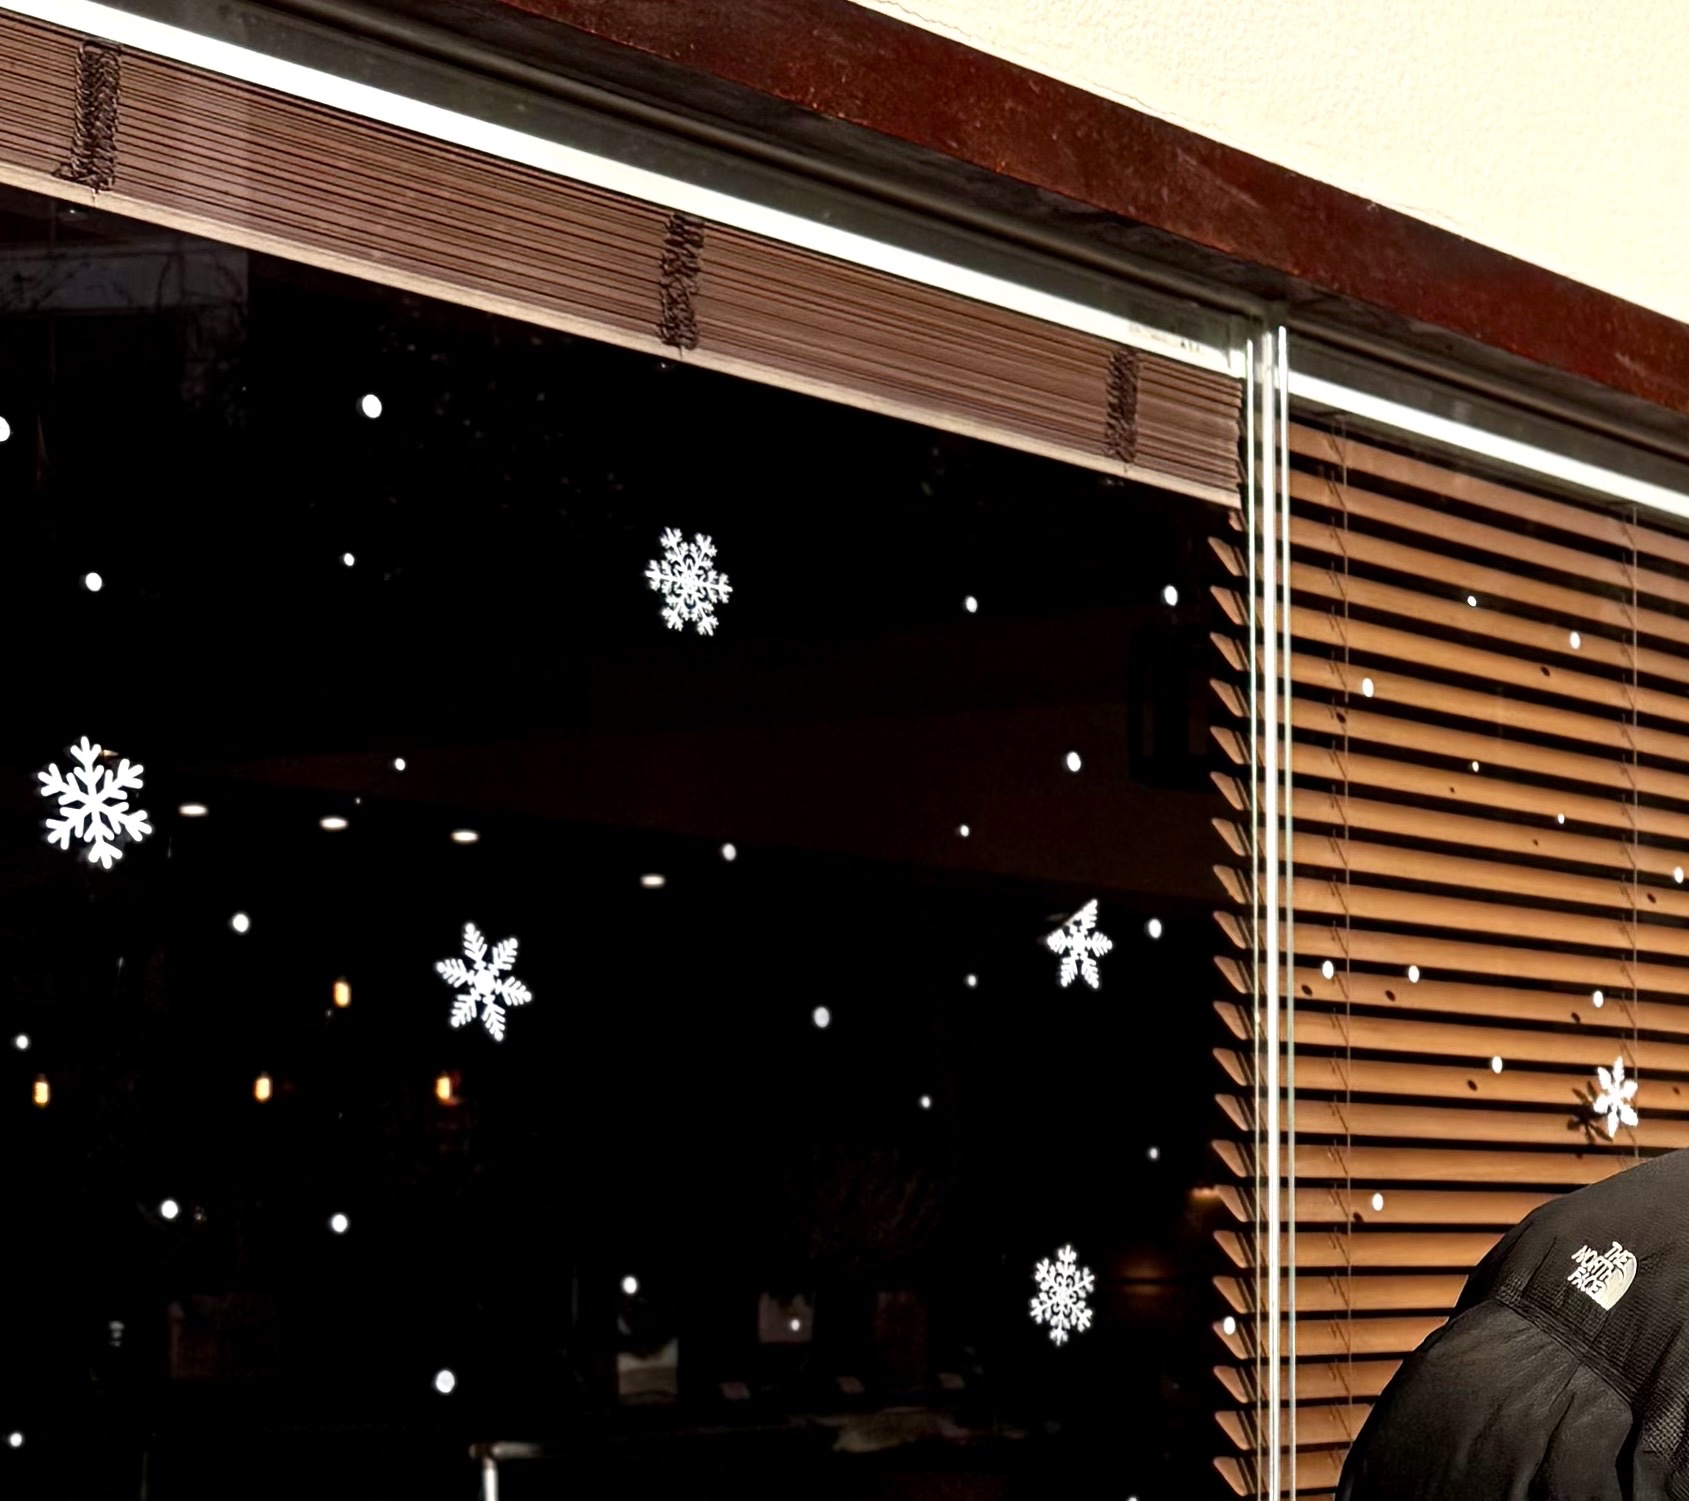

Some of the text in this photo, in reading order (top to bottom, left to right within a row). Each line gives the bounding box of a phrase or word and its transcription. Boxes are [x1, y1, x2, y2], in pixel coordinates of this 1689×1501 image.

[1571, 1244, 1615, 1281] NORTH
[1604, 1241, 1630, 1266] THE
[1567, 1266, 1604, 1294] FACE
